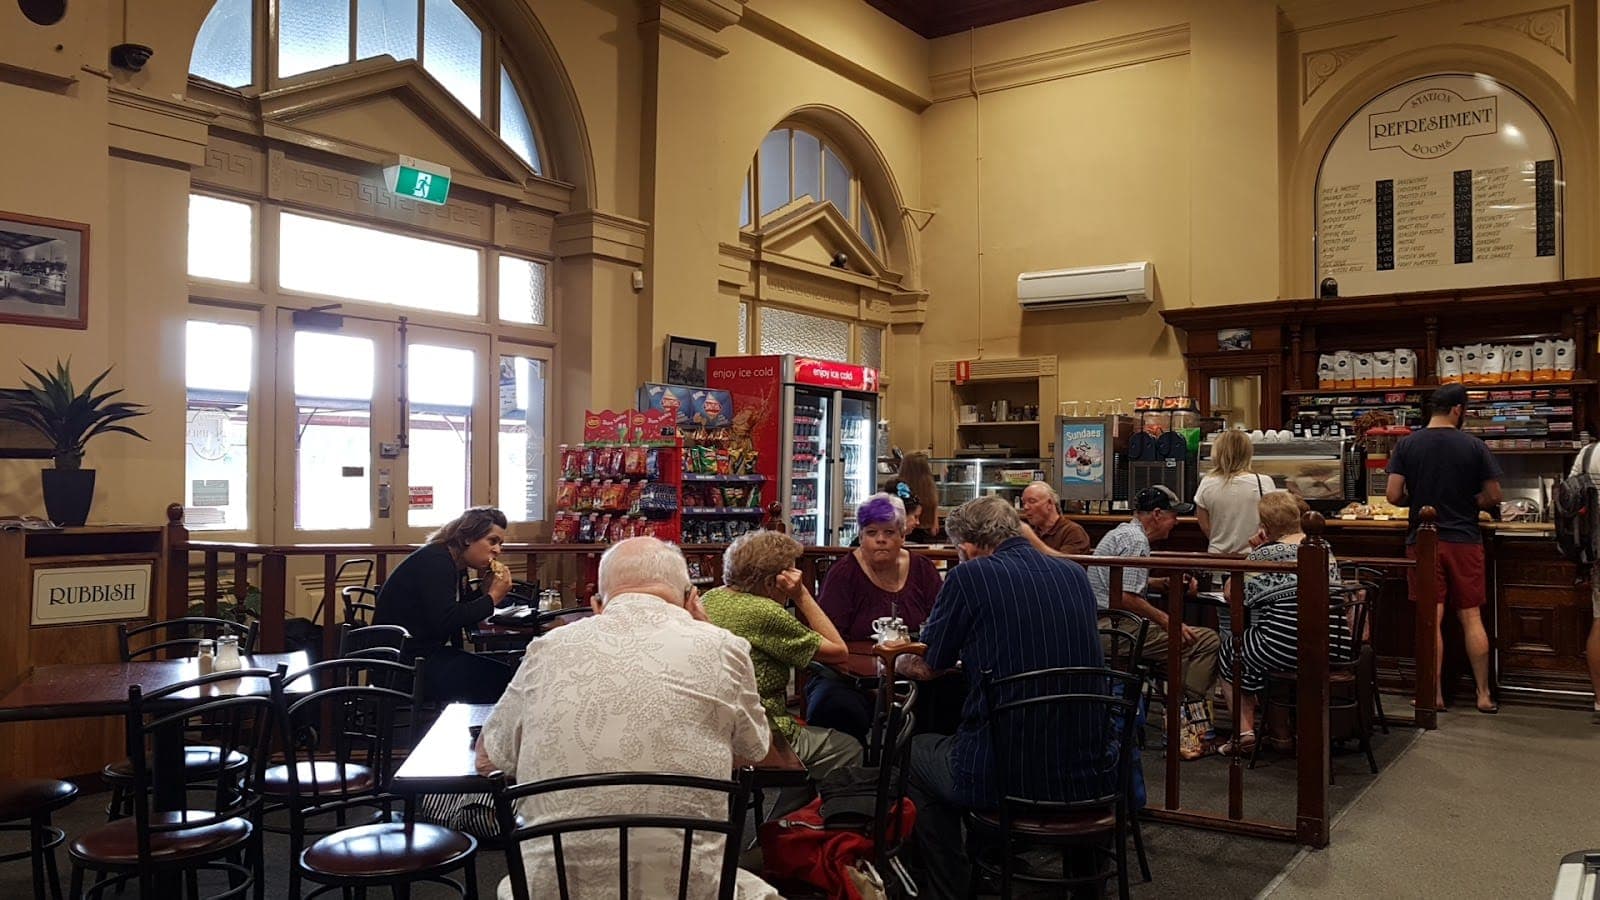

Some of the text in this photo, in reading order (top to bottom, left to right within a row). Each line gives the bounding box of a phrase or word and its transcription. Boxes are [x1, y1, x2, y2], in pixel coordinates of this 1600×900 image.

[1411, 92, 1452, 108] STATION
[1374, 108, 1493, 138] REFRESHMENT
[1412, 139, 1453, 154] ROOMS
[712, 366, 774, 379] enjoy ice cold
[813, 368, 829, 379] enjoy
[830, 369, 840, 379] ice
[840, 370, 853, 380] cold
[1066, 428, 1101, 441] Sundaes
[48, 583, 136, 605] RUBBISH
